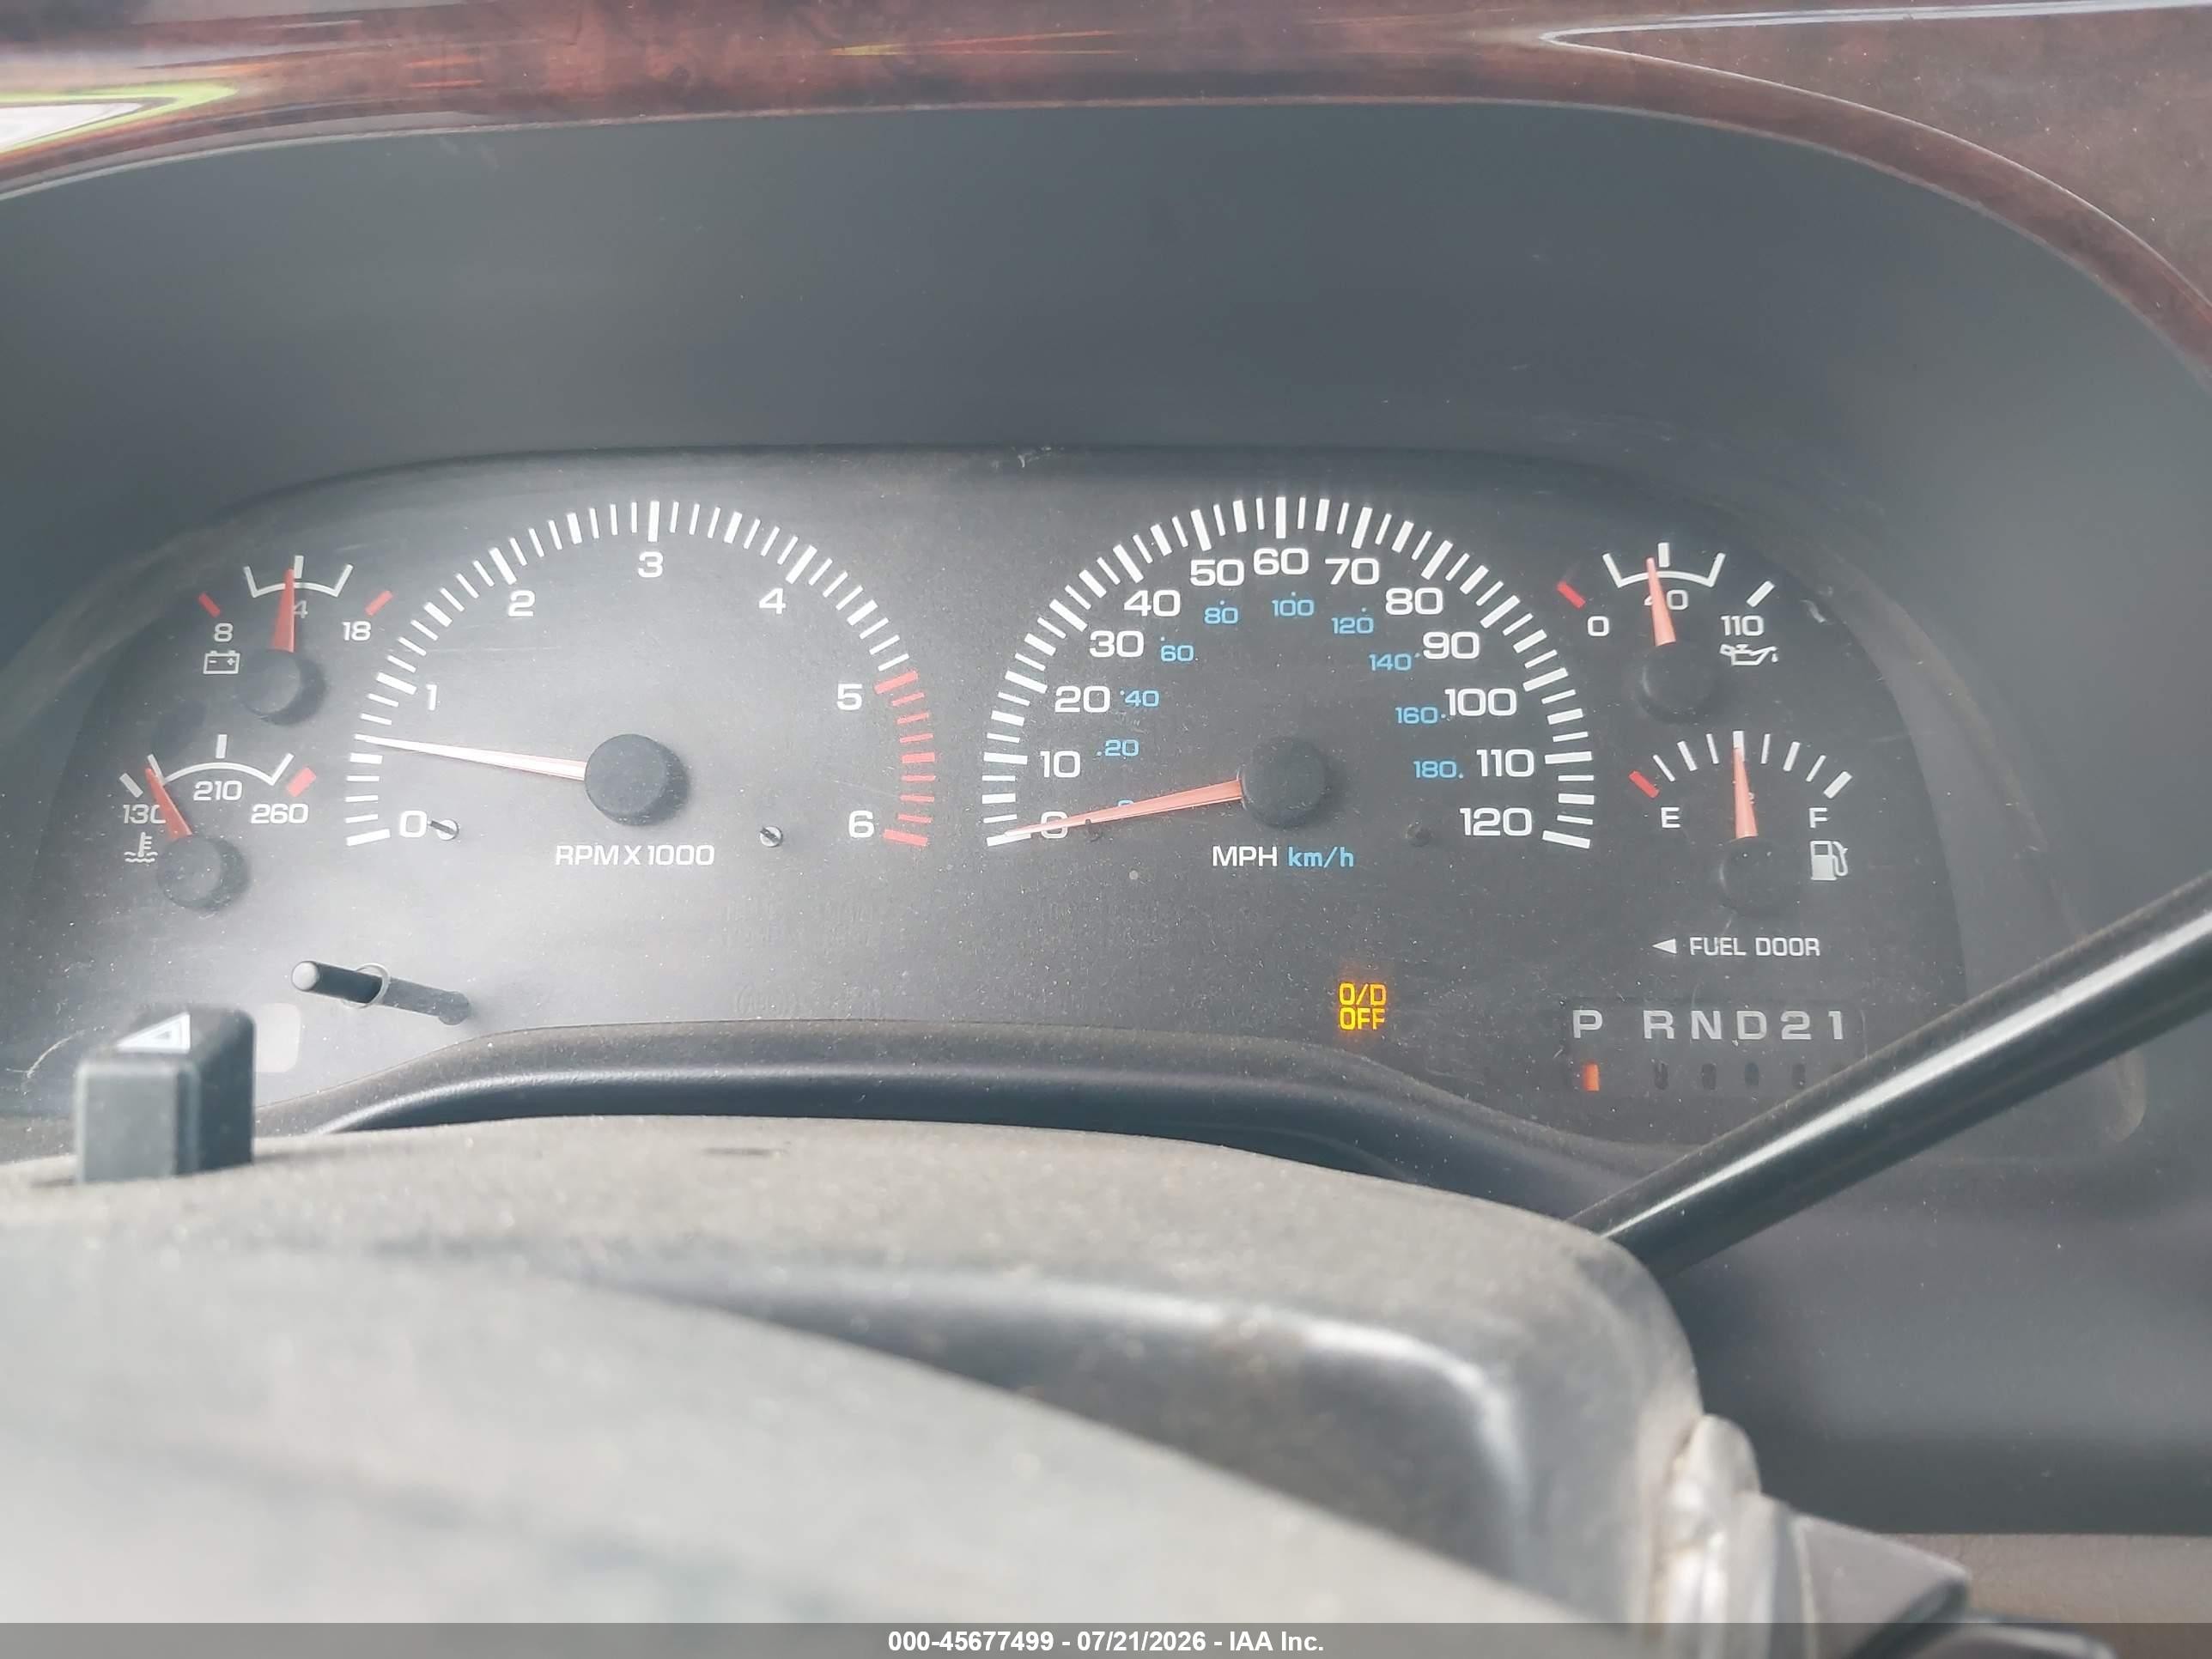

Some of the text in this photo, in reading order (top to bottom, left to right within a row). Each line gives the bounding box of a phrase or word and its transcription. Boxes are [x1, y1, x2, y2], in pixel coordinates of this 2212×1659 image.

[638, 551, 664, 579] 3
[1190, 559, 1245, 586] 50
[1253, 548, 1309, 575] 60
[1325, 558, 1380, 586] 70
[508, 590, 536, 617] 2
[759, 588, 786, 615] 4
[1124, 590, 1181, 617] 40
[1272, 599, 1315, 617] 100
[1385, 587, 1443, 615] 80
[1204, 607, 1239, 624] 80
[1331, 617, 1374, 635] 120
[1587, 616, 1610, 637] 0
[1721, 616, 1765, 636] 110
[213, 623, 234, 642] 8
[342, 621, 371, 641] 18
[1089, 630, 1145, 658] 30
[1161, 645, 1194, 662] 60
[1423, 631, 1480, 659] 90
[1369, 653, 1412, 671] 140
[426, 684, 439, 711] 1
[836, 684, 862, 711] 5
[1054, 686, 1111, 714] 20
[1125, 690, 1159, 708] 40
[1444, 688, 1517, 716] 100
[1395, 707, 1437, 724] 160
[1104, 739, 1139, 757] 20
[1040, 750, 1081, 779] 10
[1413, 761, 1457, 779] 180
[1476, 749, 1534, 777] 110
[193, 781, 242, 801] 210
[251, 804, 309, 824] 260
[399, 810, 428, 839] 0
[848, 811, 875, 839] 6
[1460, 808, 1533, 836] 120
[1661, 807, 1680, 829] E
[1809, 807, 1828, 828] F
[556, 845, 715, 866] RPM X 1000
[1212, 845, 1354, 868] MPH km/h
[1690, 937, 1820, 957] FUEL DOOR
[1339, 982, 1387, 1006] O/D
[1340, 1007, 1385, 1030] OFF
[1572, 1009, 1603, 1039] P
